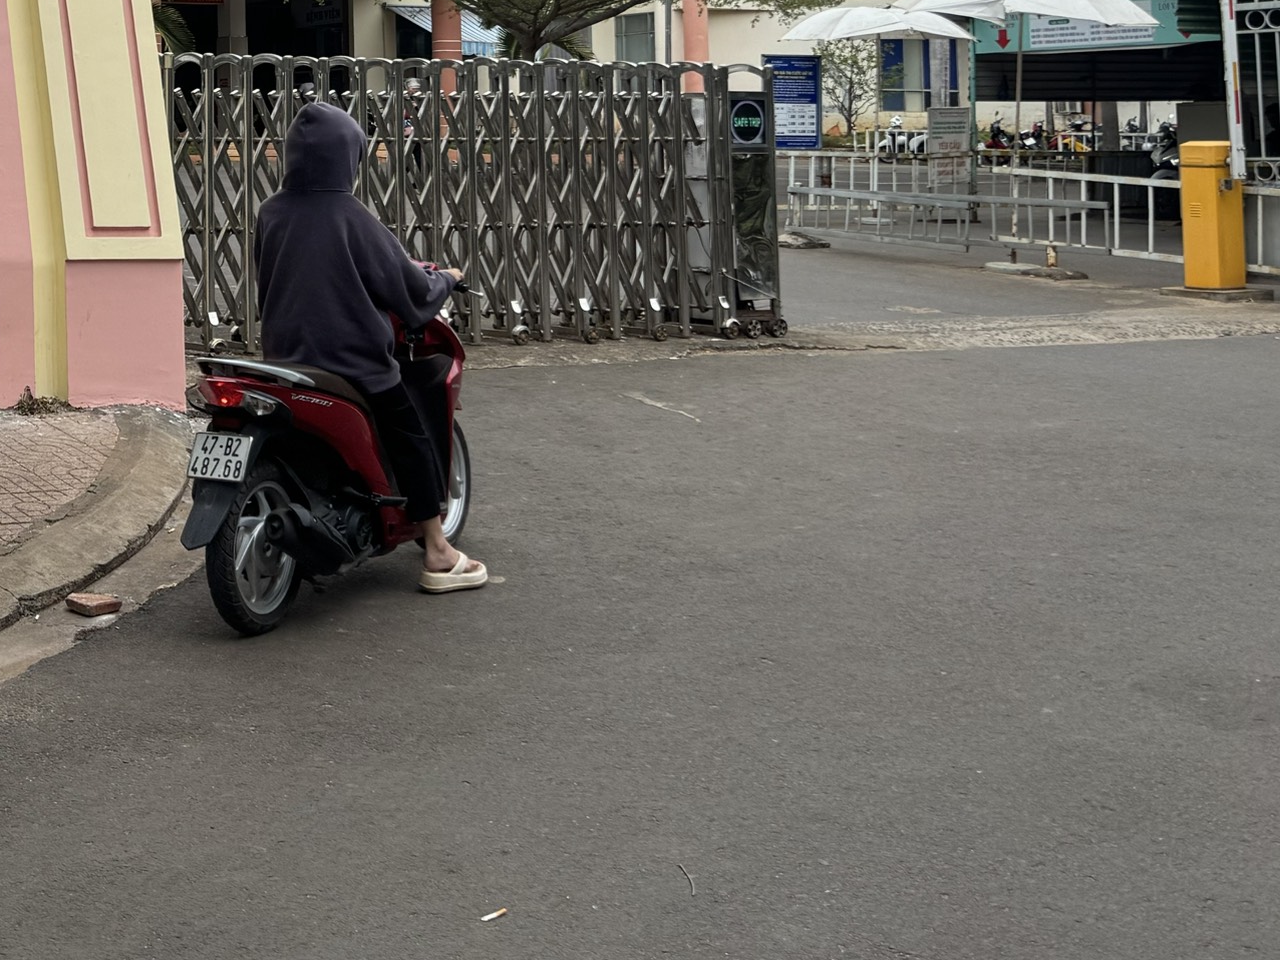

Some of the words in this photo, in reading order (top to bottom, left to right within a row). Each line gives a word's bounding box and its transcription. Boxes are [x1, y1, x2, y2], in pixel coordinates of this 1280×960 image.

[290, 392, 334, 407] VISION
[201, 435, 242, 457] 47-B2
[190, 456, 243, 479] 487.68
